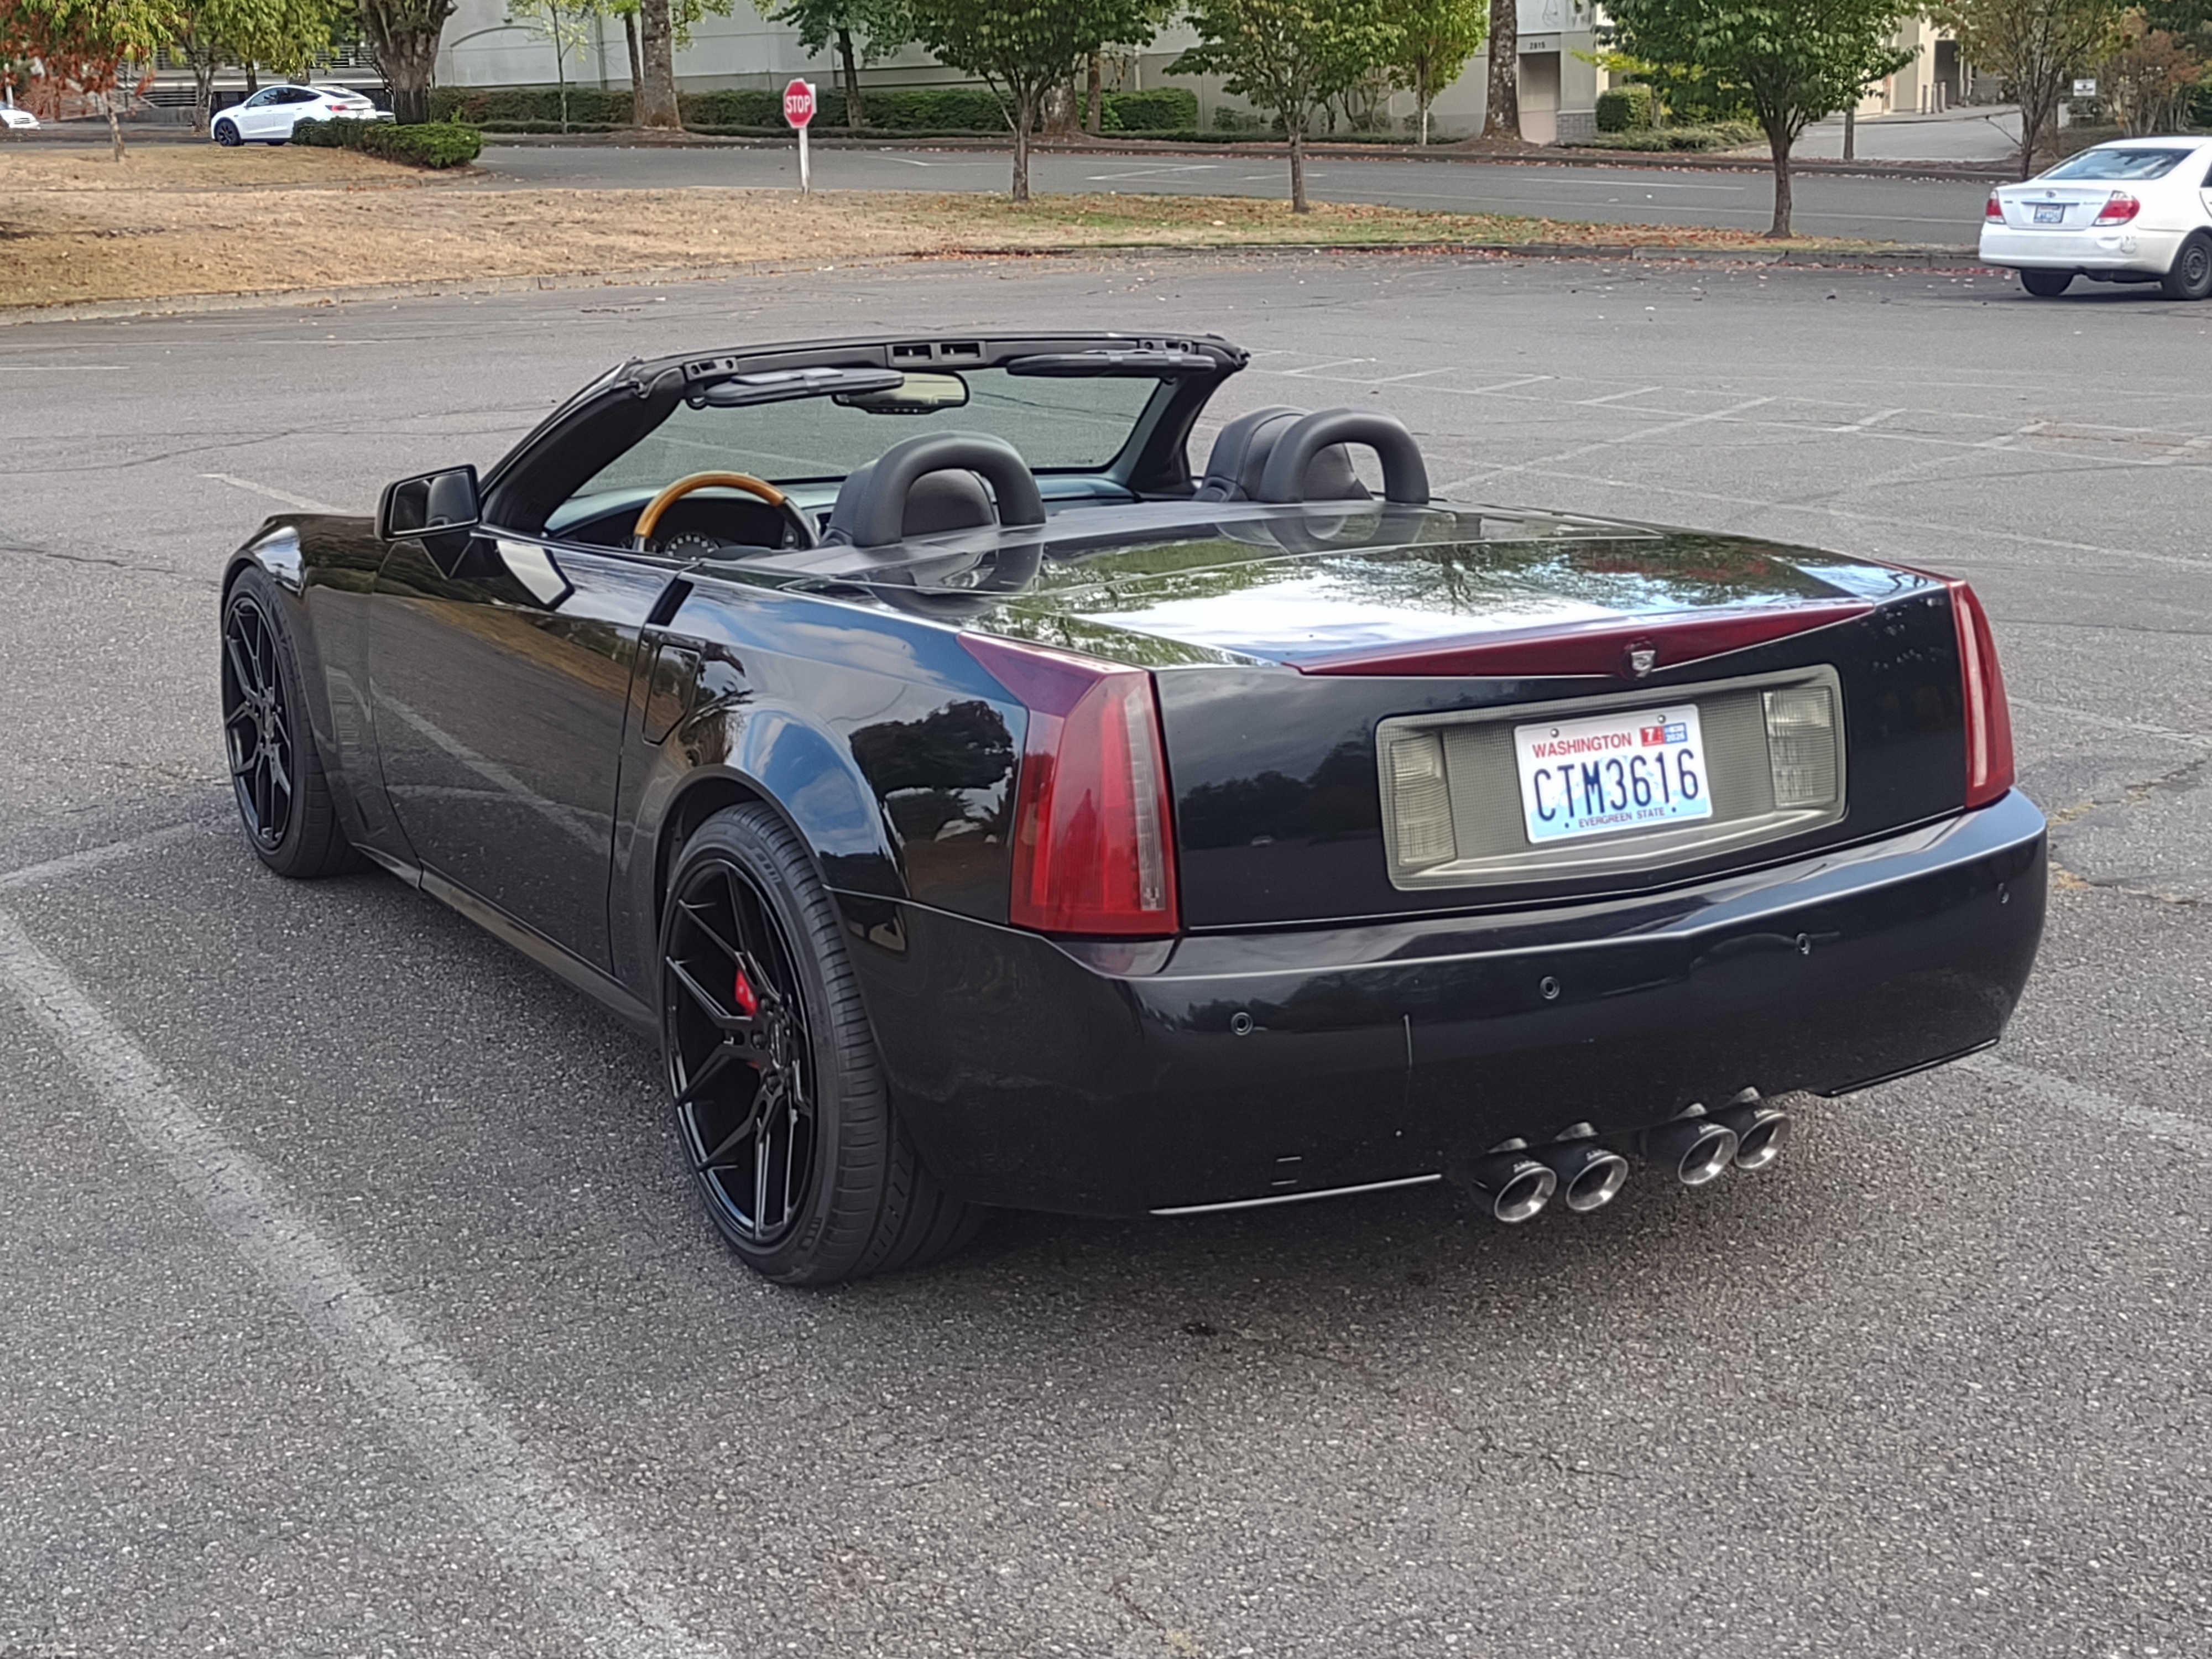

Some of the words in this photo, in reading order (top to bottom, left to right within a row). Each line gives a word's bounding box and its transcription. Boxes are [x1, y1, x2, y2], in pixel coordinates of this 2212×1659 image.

[786, 95, 811, 113] STOP
[1532, 732, 1632, 758] WASHINGTON
[1645, 728, 1654, 742] 7
[1533, 748, 1698, 822] CTM3616
[1579, 812, 1632, 828] EVERGREEN
[1636, 807, 1665, 820] STATE
